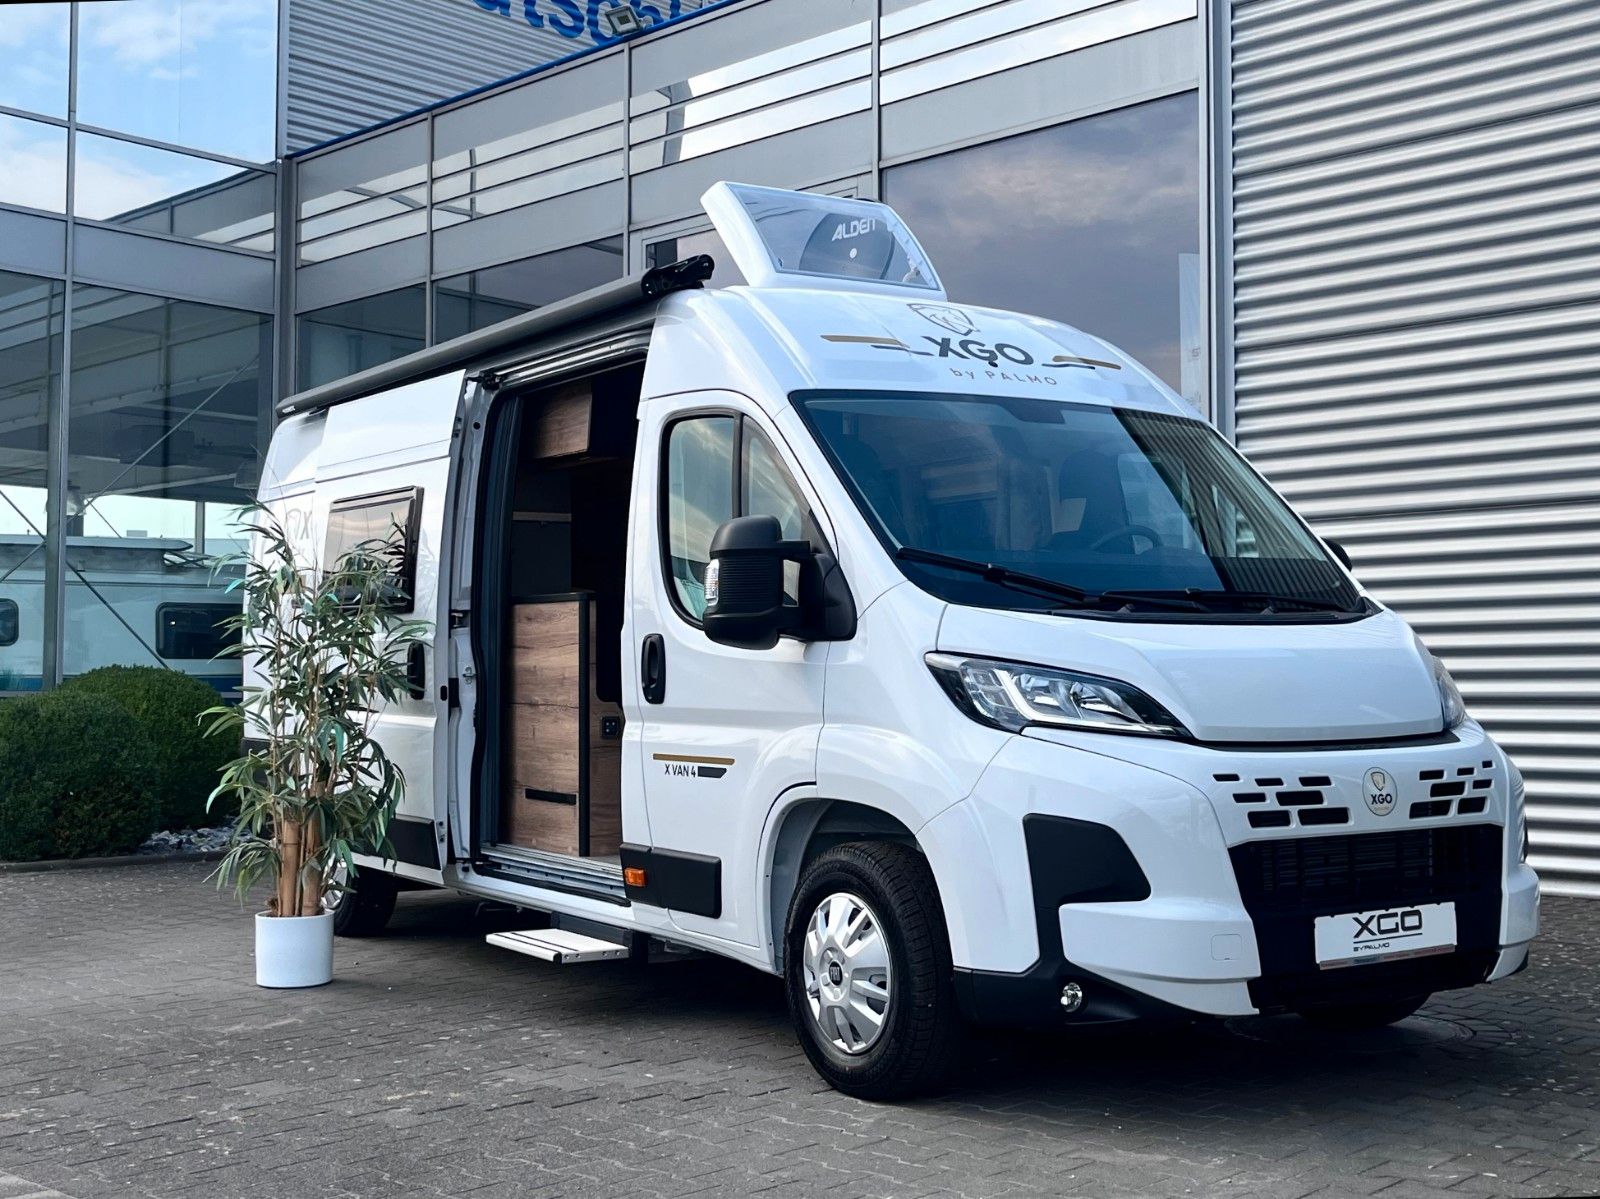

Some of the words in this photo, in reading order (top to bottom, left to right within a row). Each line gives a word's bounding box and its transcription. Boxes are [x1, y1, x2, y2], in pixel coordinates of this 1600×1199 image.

[920, 335, 1035, 366] XGO
[949, 367, 975, 380] by
[986, 370, 1058, 386] PALMO
[664, 763, 671, 776] X
[672, 764, 690, 777] VAN
[690, 765, 696, 778] 4
[1370, 793, 1393, 805] XGO
[1352, 909, 1423, 939] XGO
